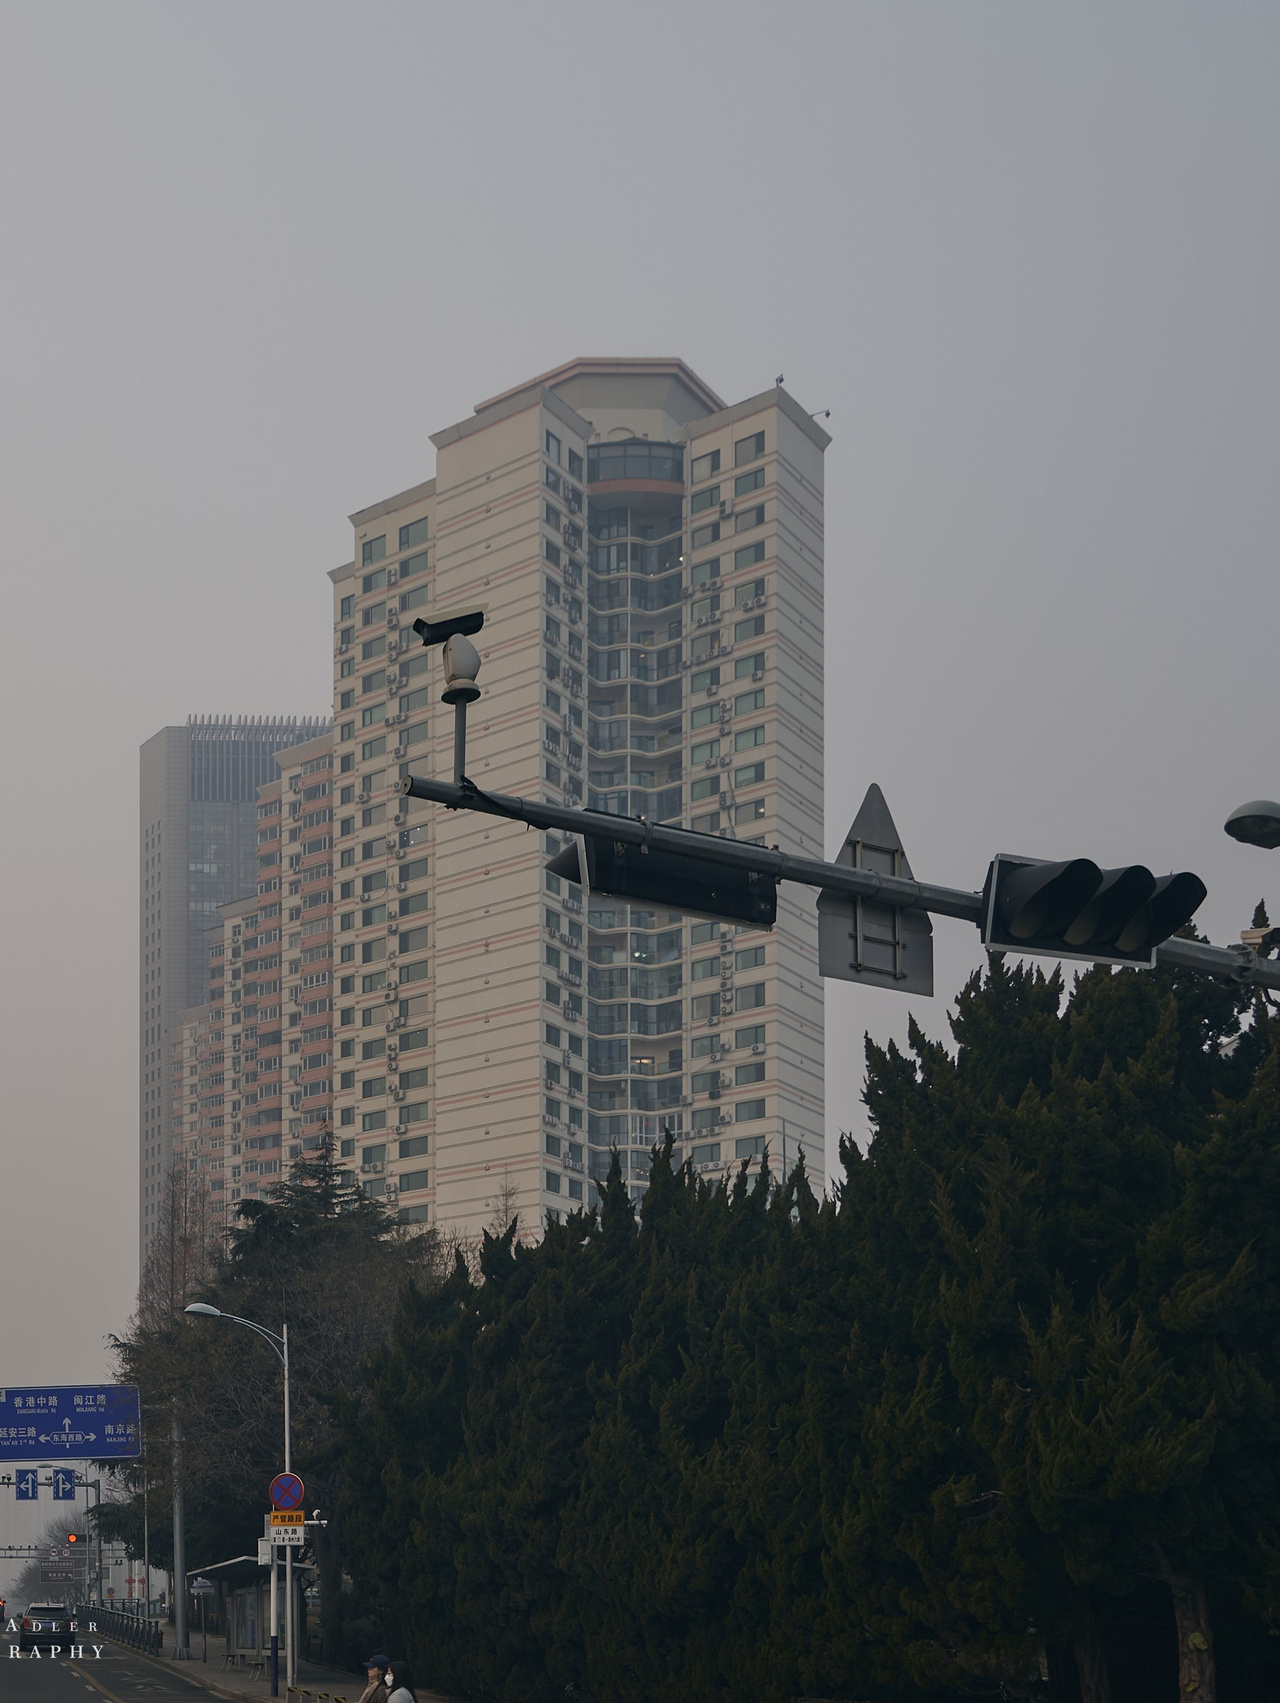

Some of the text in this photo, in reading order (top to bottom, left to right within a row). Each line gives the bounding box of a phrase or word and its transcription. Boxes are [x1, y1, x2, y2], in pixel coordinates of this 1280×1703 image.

[13, 1395, 58, 1408] 香港中路
[73, 1394, 107, 1406] 闽江路
[104, 1423, 137, 1435] 南京路
[0, 1438, 18, 1446] YAN'AN
[52, 1433, 83, 1442] 东海西路
[272, 1514, 302, 1523] 严管路段
